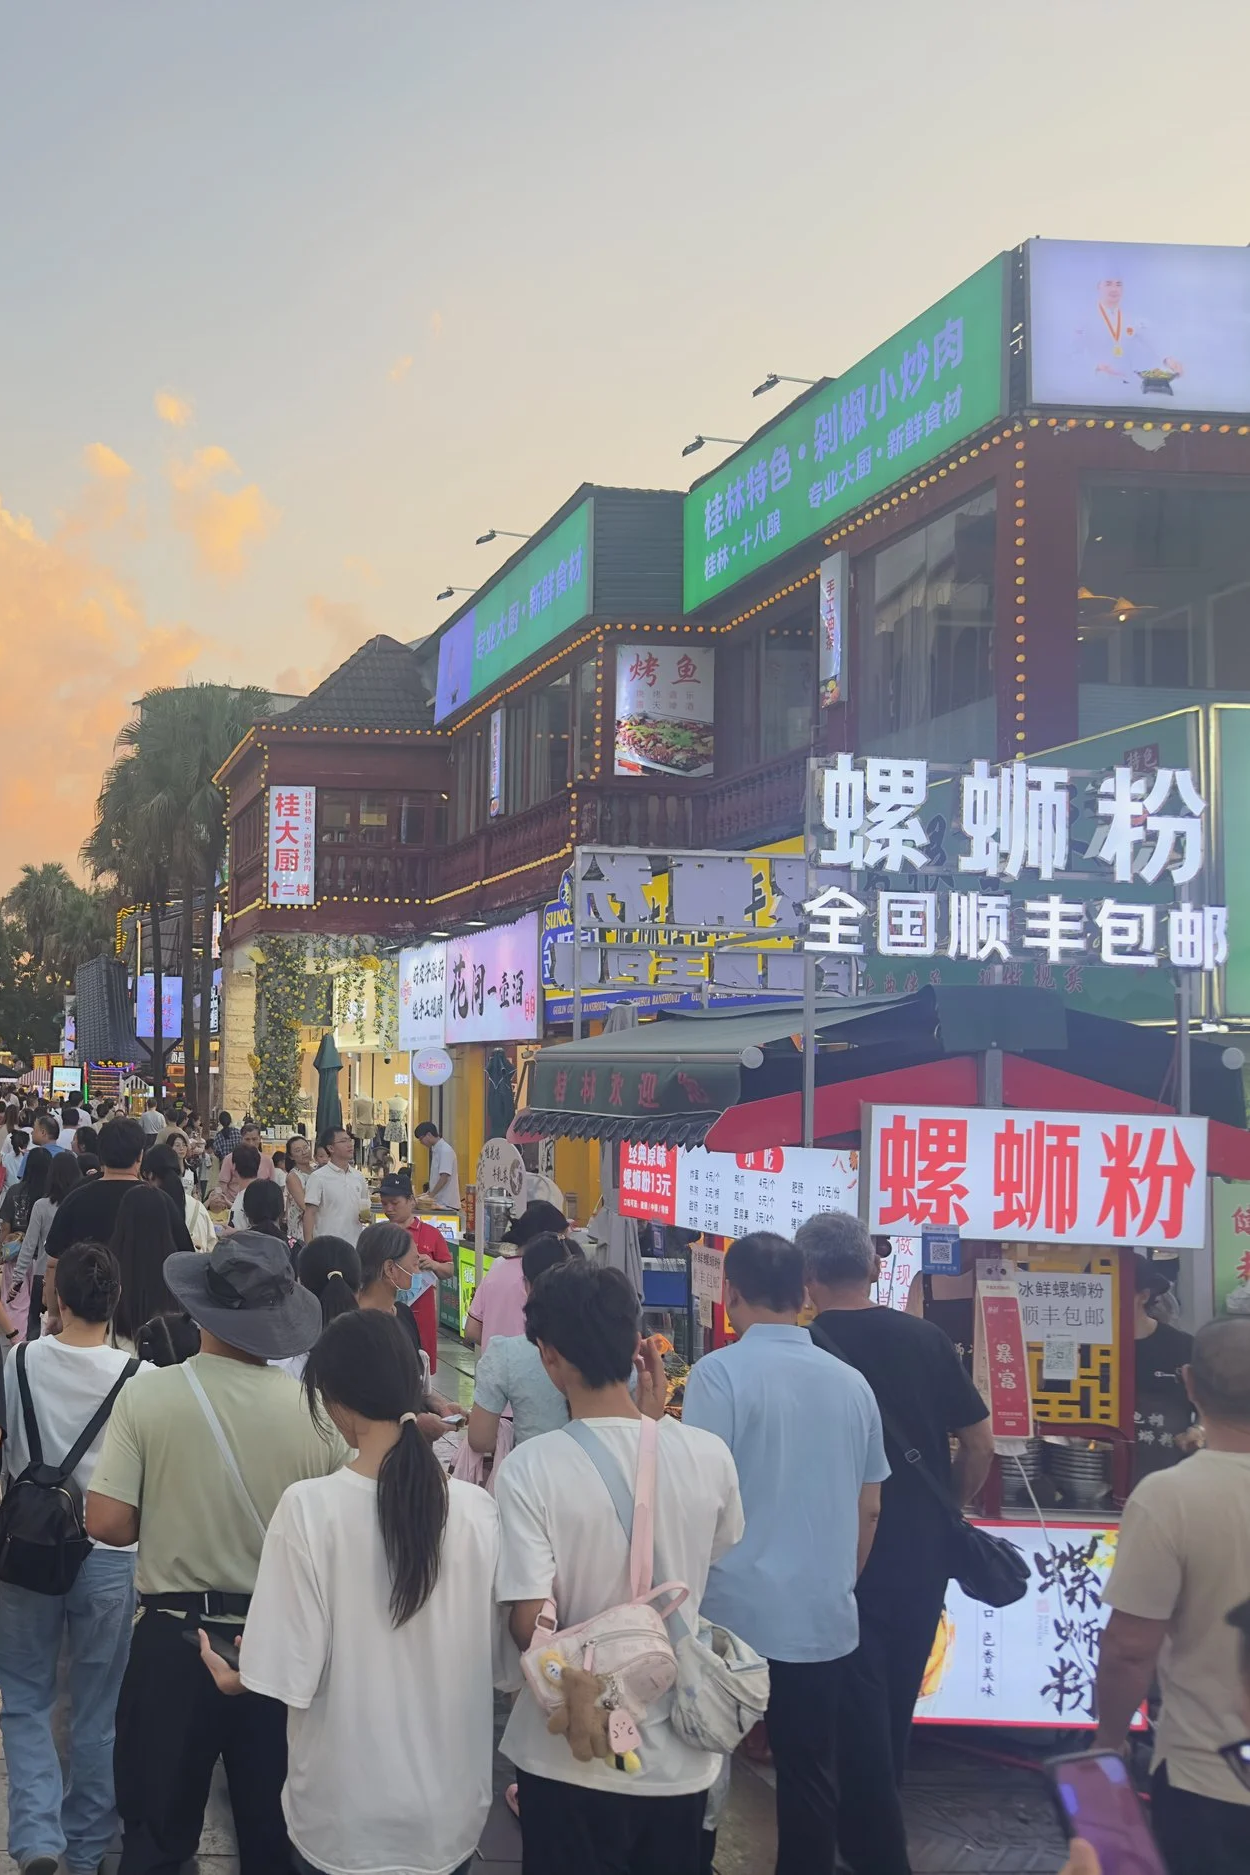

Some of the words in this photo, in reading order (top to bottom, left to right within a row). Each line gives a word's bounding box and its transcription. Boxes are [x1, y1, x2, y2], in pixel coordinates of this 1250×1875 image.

[629, 651, 701, 687] 烤鱼
[274, 792, 300, 873] 桂大厨
[819, 752, 1206, 884] 螺蛳粉
[282, 883, 311, 897] 二楼
[804, 886, 1228, 970] 全国顺丰包邮
[623, 1168, 671, 1197] 螺蛳粉13元
[744, 1148, 775, 1171] 小吃
[879, 1113, 1196, 1239] 螺蛳粉
[1018, 1280, 1105, 1299] 冰鲜螺蛳粉
[1023, 1305, 1105, 1327] 顺丰包邮
[995, 1343, 1016, 1390] 暴富
[1034, 1536, 1102, 1721] 螺蛳粉
[981, 1631, 995, 1697] 色香美味
